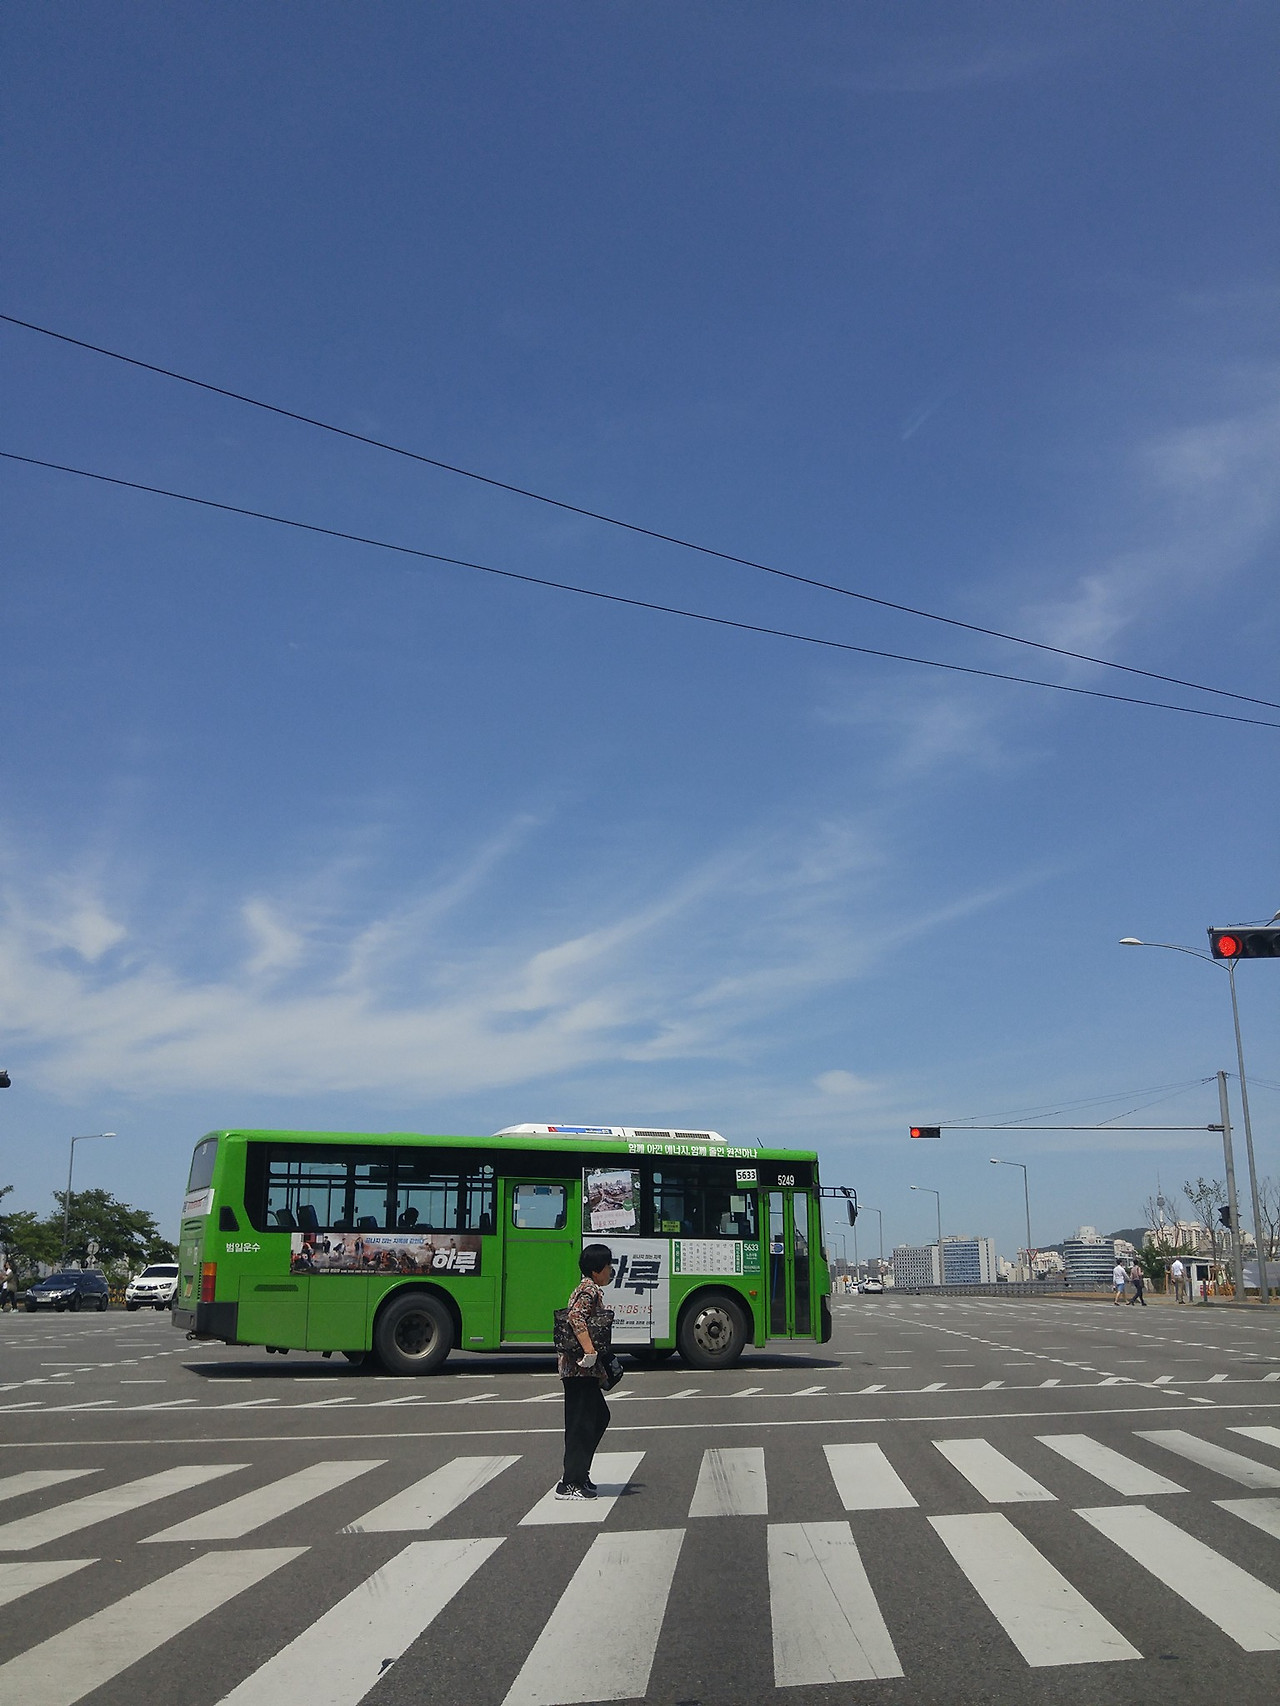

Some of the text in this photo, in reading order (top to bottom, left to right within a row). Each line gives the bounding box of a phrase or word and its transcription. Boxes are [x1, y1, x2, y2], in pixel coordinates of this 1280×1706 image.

[628, 1143, 645, 1154] 함께
[647, 1144, 663, 1155] 아낀
[691, 1146, 707, 1157] 함께
[709, 1146, 725, 1158] 줄인
[726, 1147, 758, 1159] 원전하나
[737, 1171, 756, 1180] 5633
[777, 1175, 795, 1186] 5249
[225, 1242, 261, 1253] 범일운수
[743, 1243, 759, 1252] 5633
[432, 1247, 478, 1274] 하루
